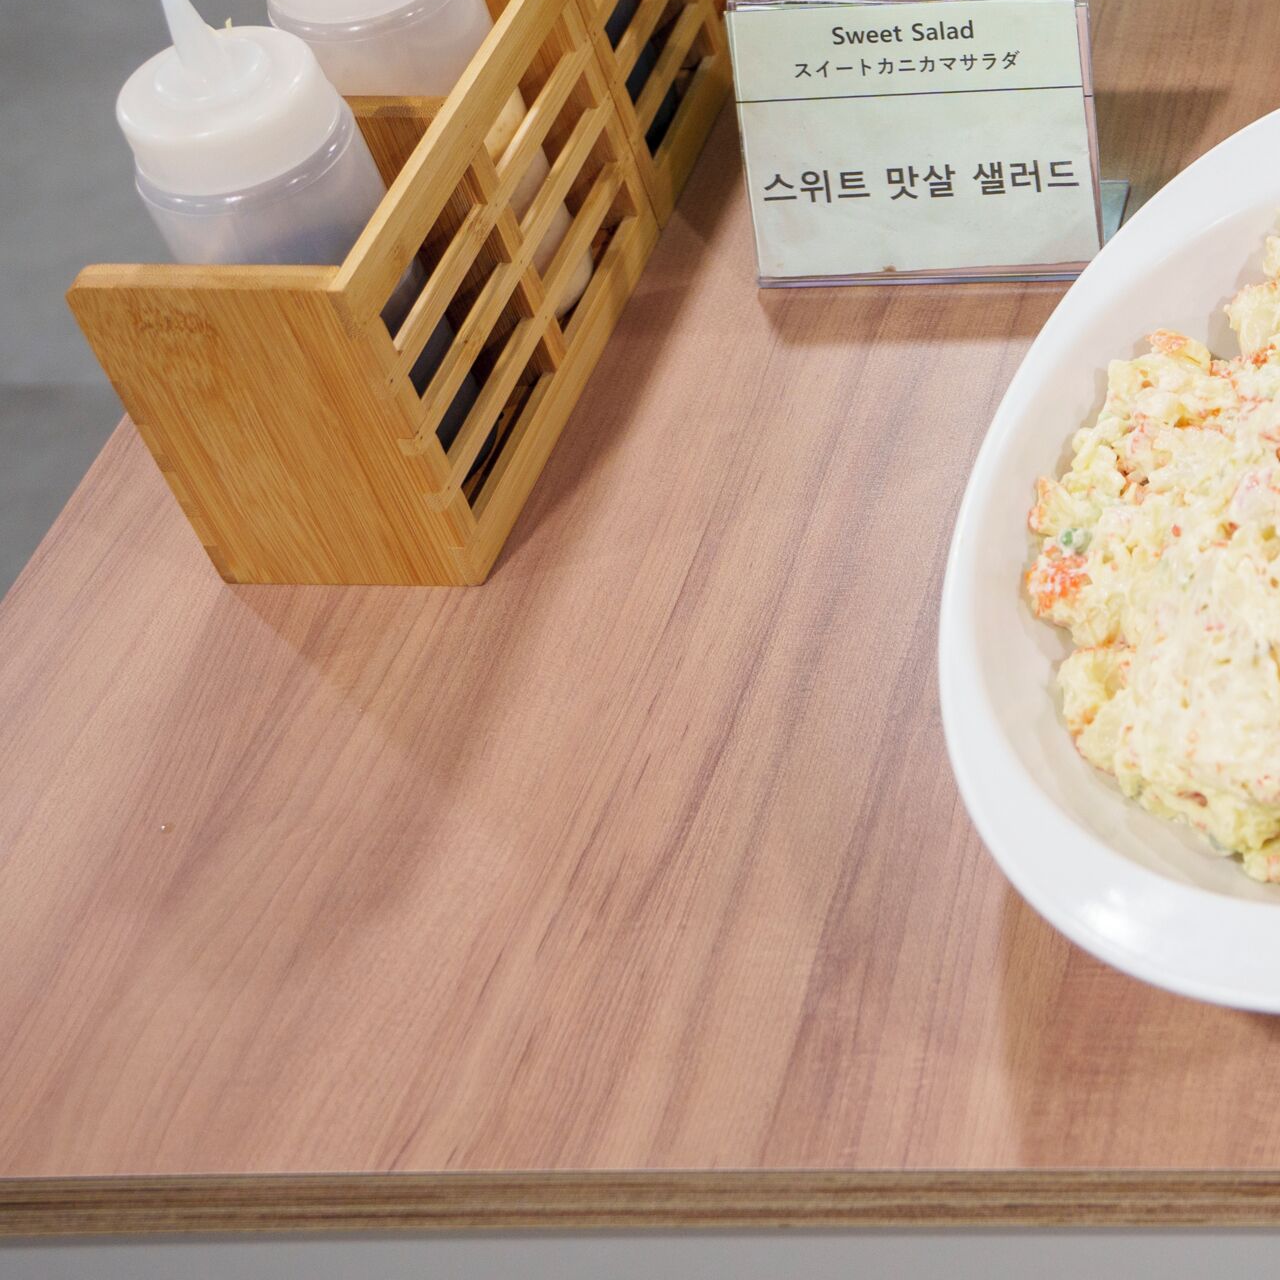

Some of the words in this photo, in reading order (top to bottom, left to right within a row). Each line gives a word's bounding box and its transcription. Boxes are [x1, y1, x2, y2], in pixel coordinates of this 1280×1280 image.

[832, 24, 902, 45] Sweet
[912, 20, 974, 42] Salad
[794, 50, 1021, 78] スイートカニカマサラダ
[763, 169, 871, 203] 스위트
[886, 163, 955, 200] 맛살
[973, 159, 1080, 197] 샐러드
